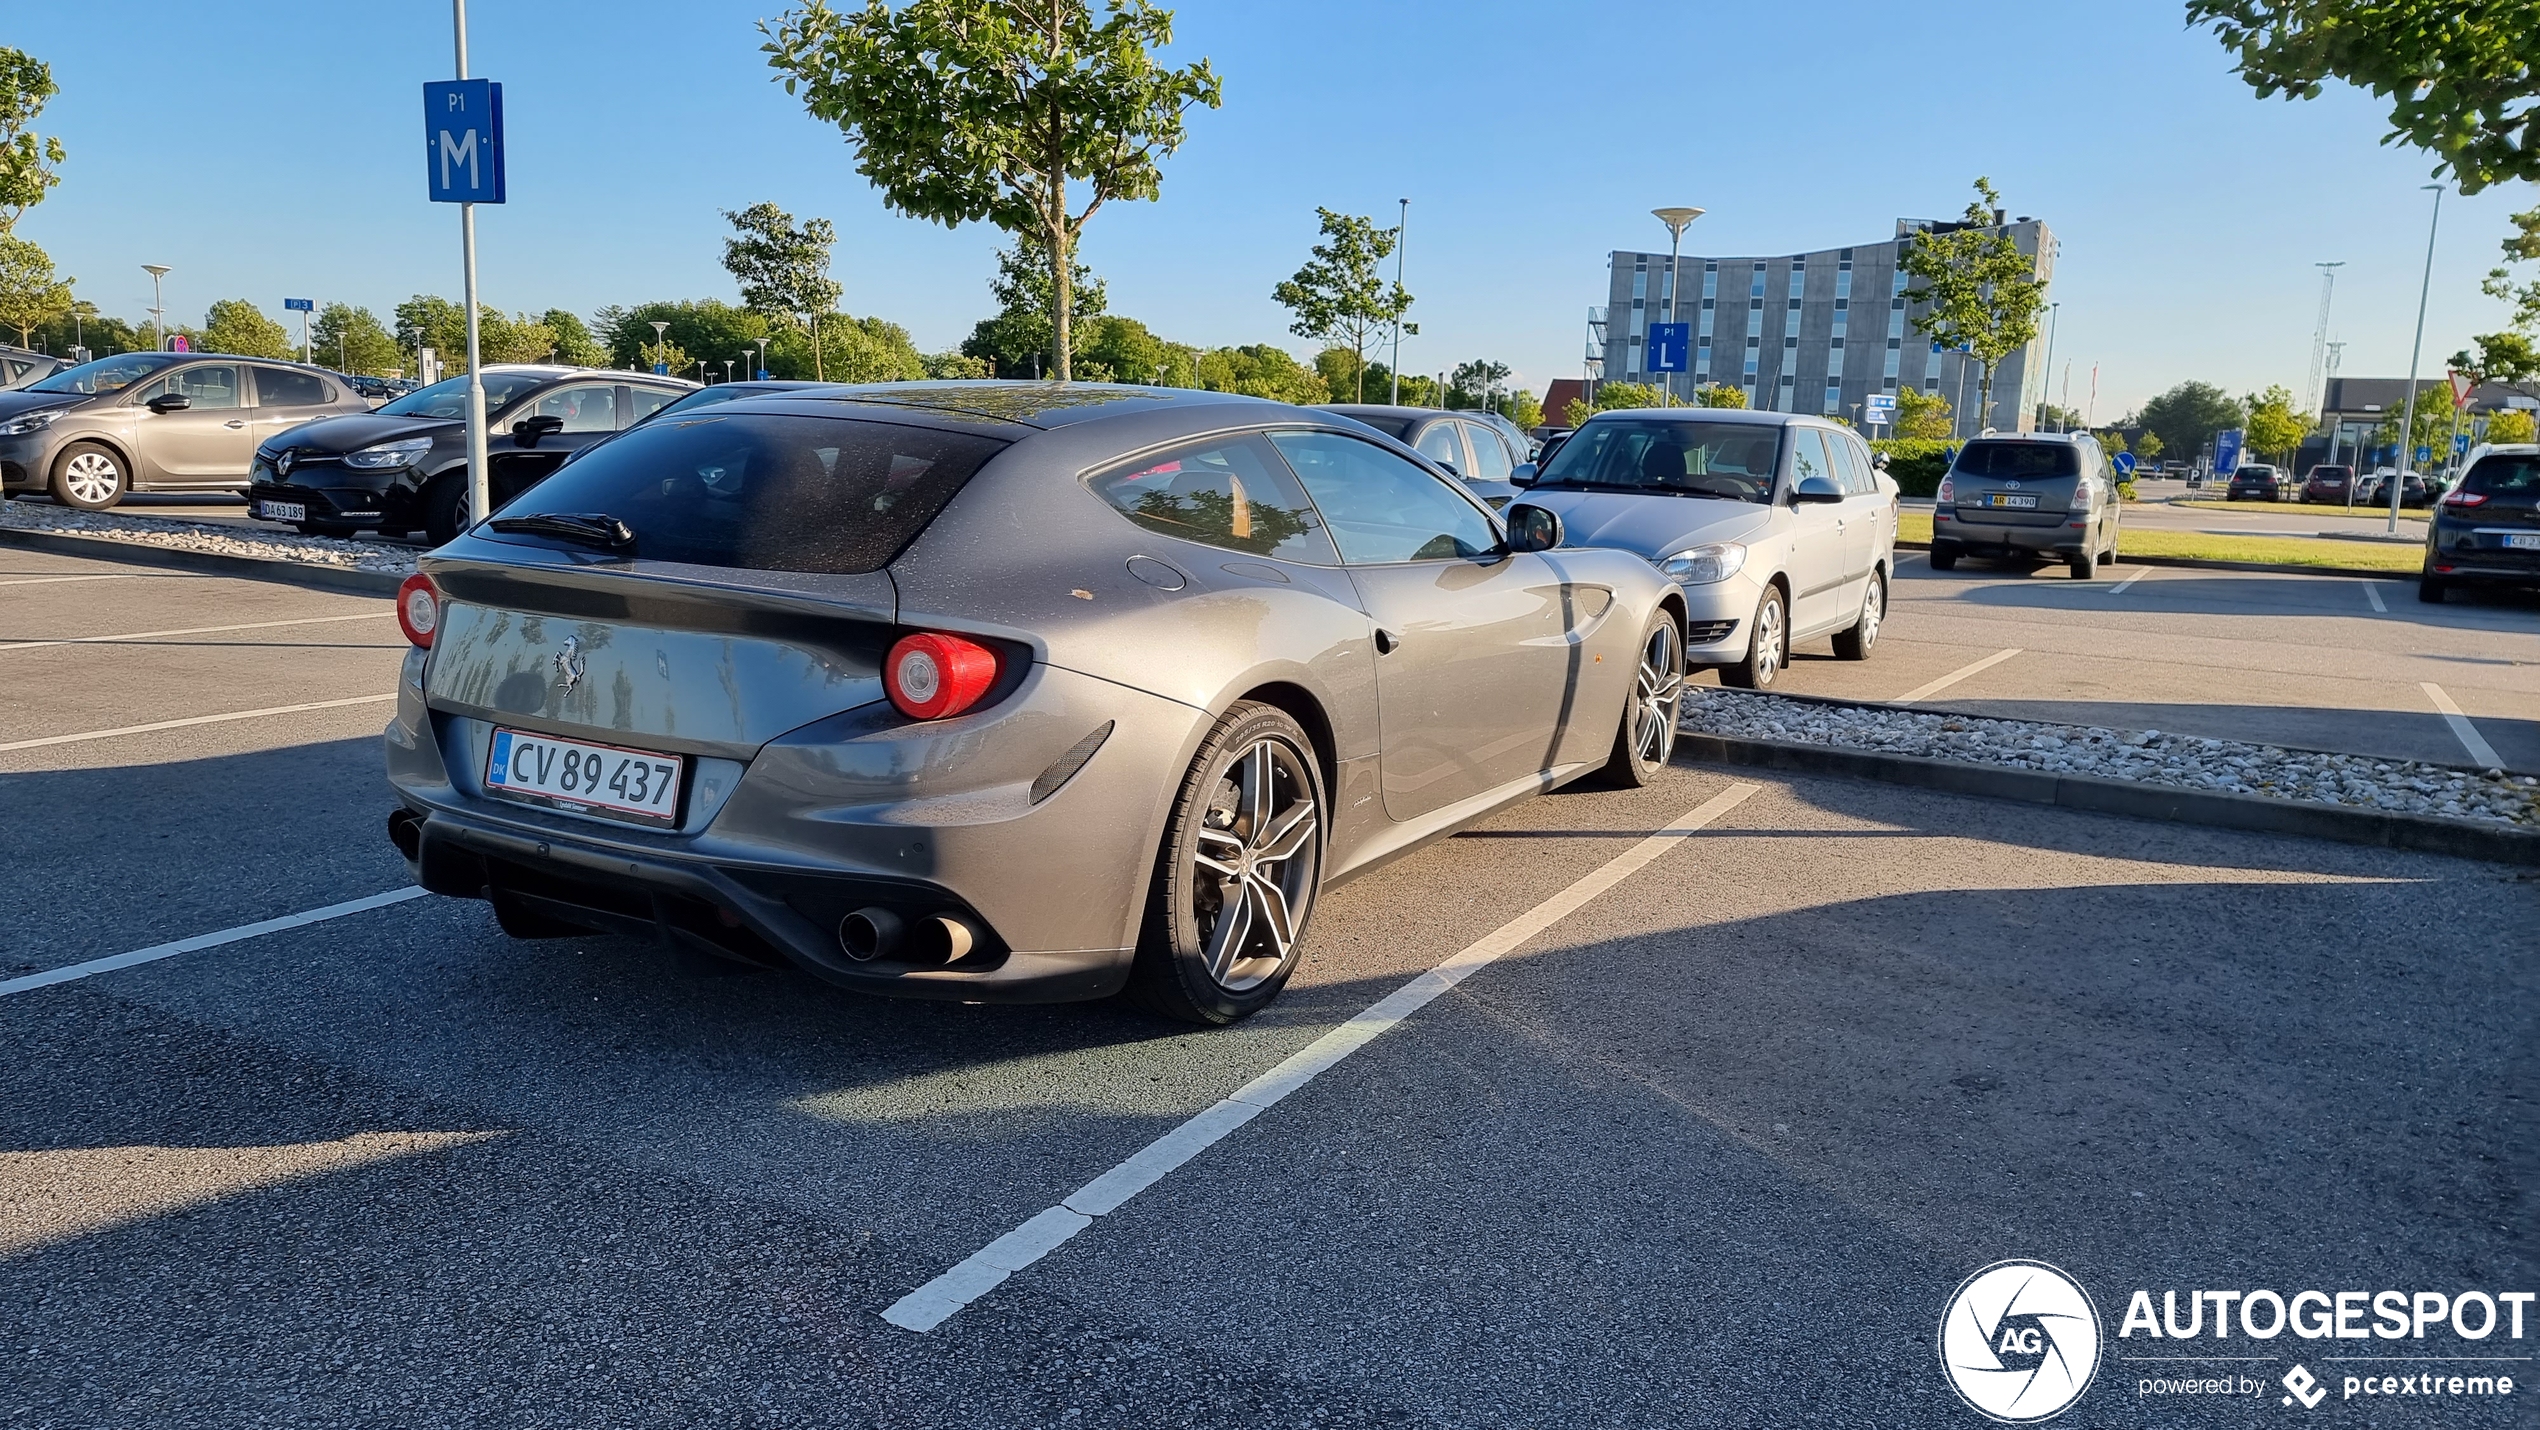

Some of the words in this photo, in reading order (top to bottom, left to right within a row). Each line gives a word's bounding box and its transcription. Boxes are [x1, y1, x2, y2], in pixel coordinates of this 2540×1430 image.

[448, 93, 465, 112] P1
[440, 129, 479, 190] M
[302, 301, 308, 309] 3
[1664, 328, 1674, 336] P1
[1660, 342, 1674, 368] L
[2455, 440, 2465, 452] H
[2420, 452, 2428, 461] G
[2191, 470, 2200, 481] P
[1993, 496, 2005, 505] AR
[2007, 497, 2017, 505] 14
[2018, 497, 2035, 506] 390
[265, 503, 276, 516] DA
[276, 504, 287, 517] 63
[288, 506, 303, 519] 189
[493, 763, 506, 776] DK
[512, 743, 556, 785] CV
[560, 750, 602, 795] 89
[609, 759, 674, 805] 437
